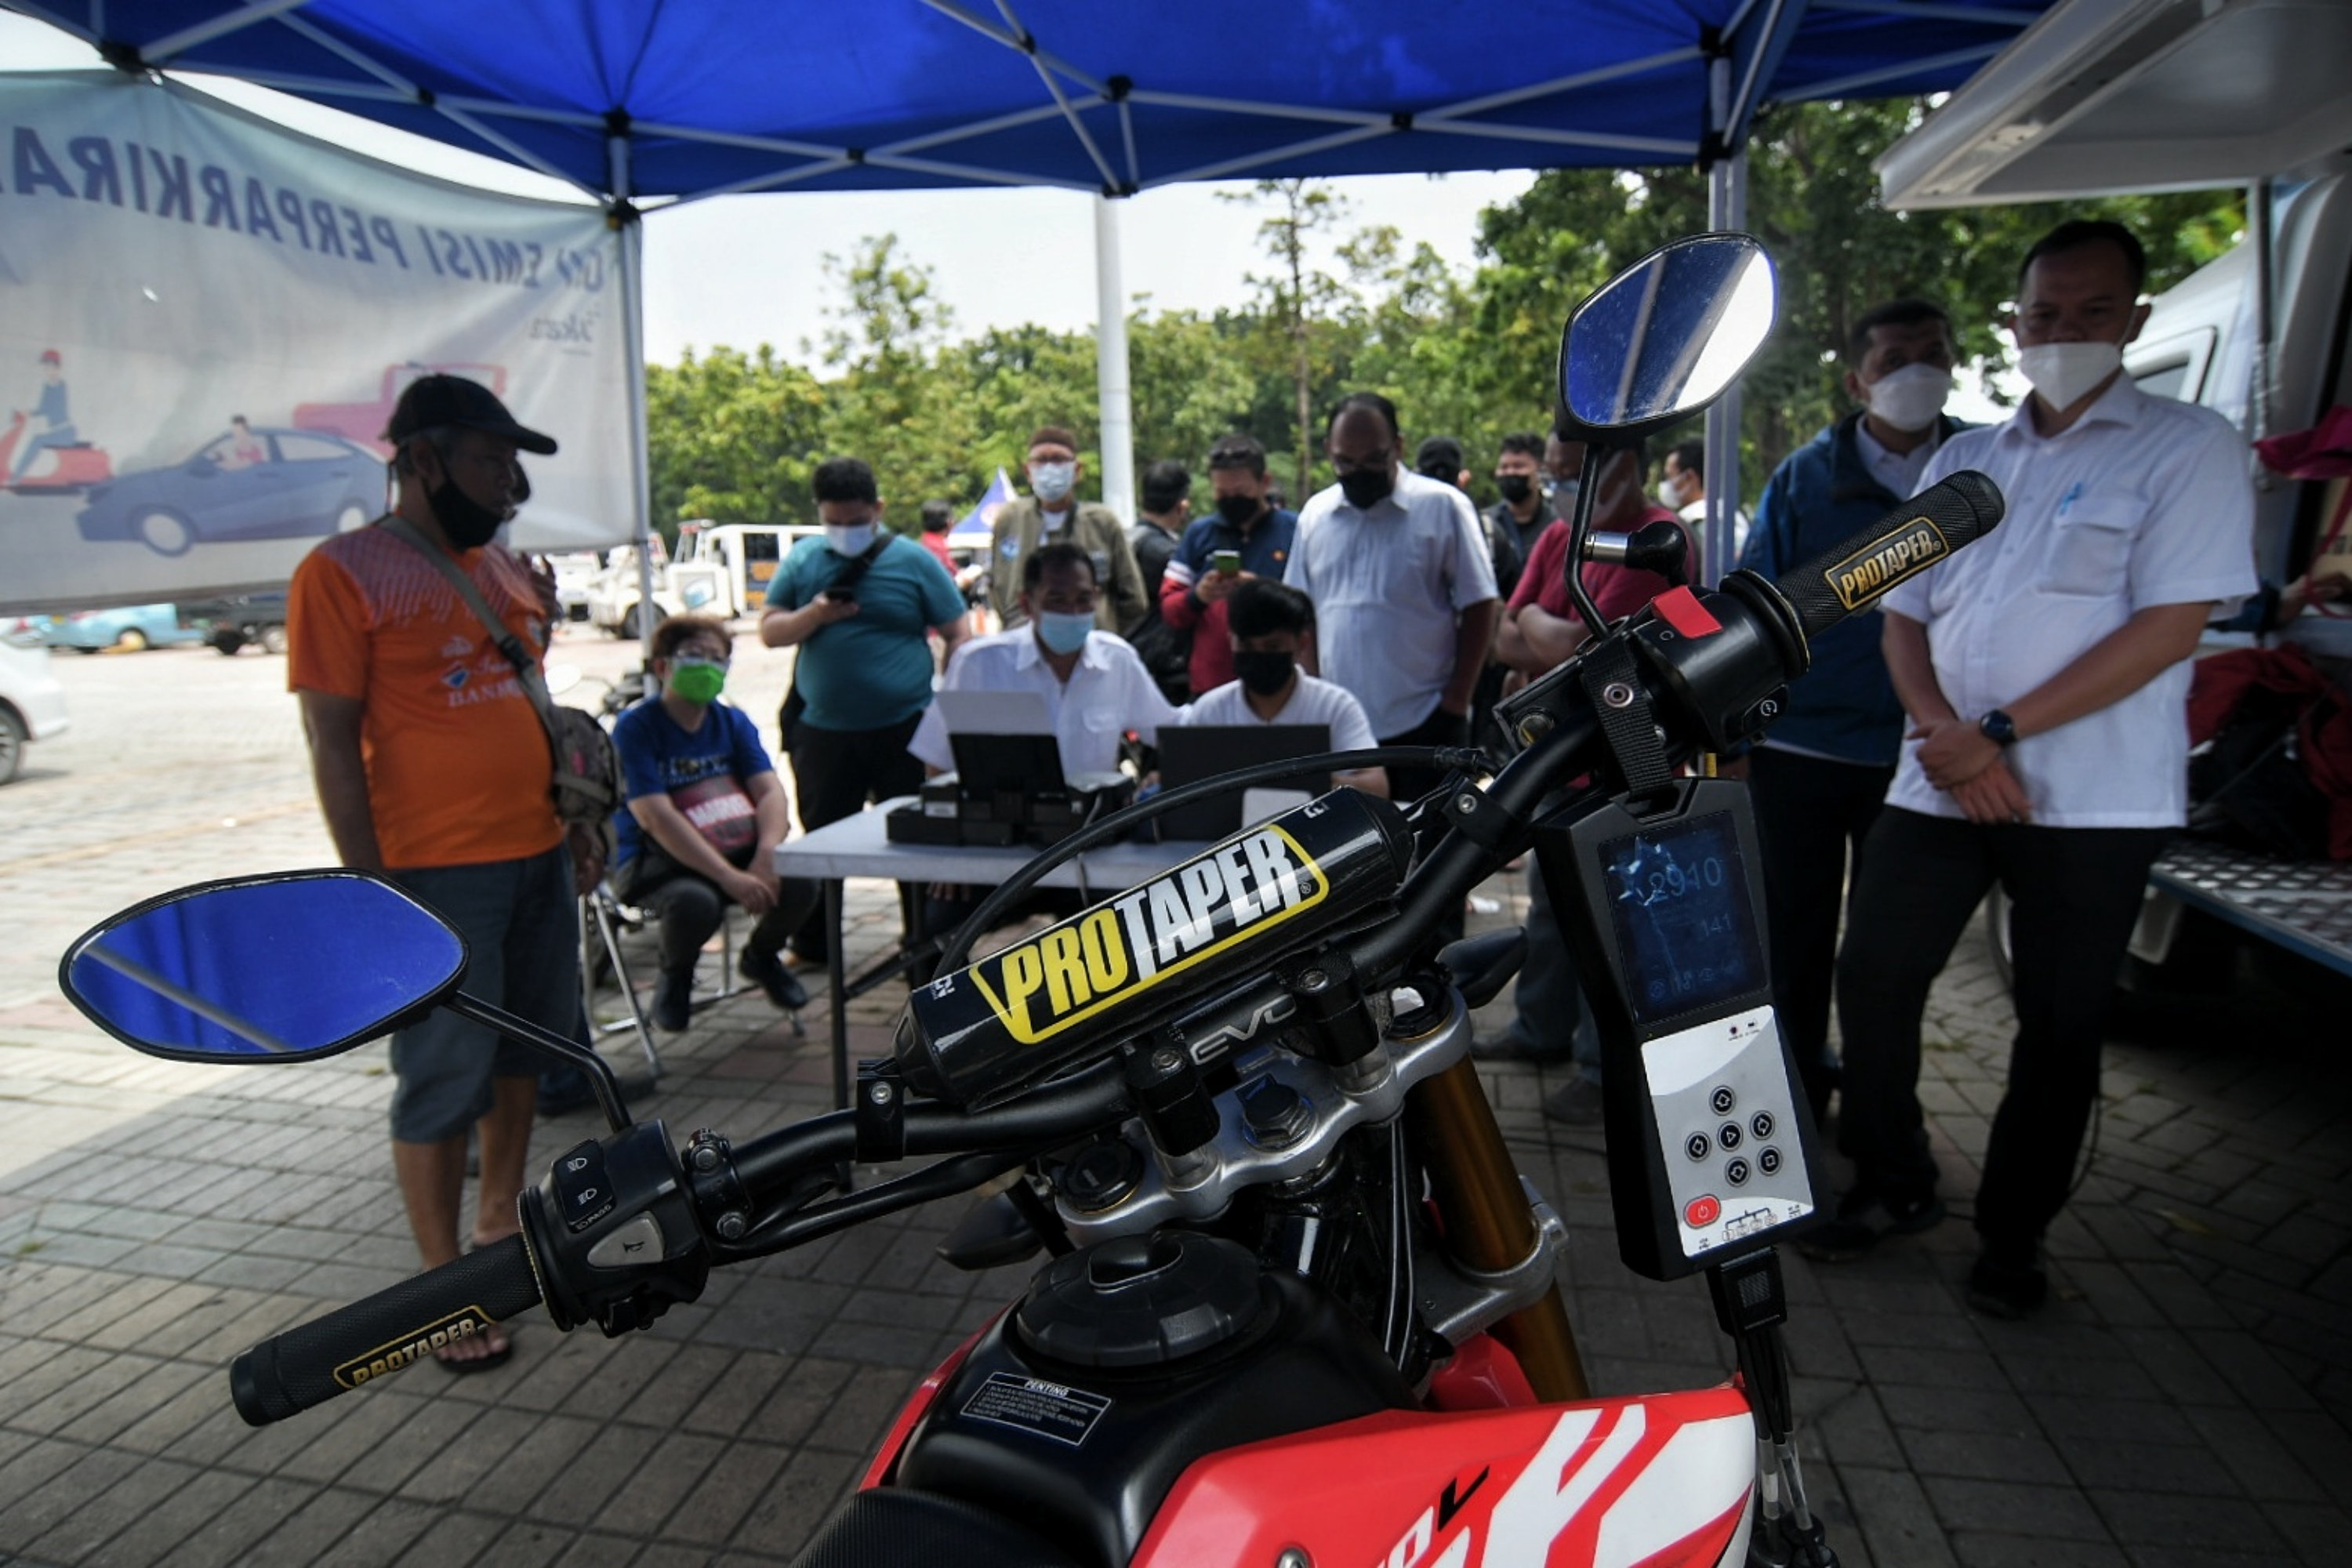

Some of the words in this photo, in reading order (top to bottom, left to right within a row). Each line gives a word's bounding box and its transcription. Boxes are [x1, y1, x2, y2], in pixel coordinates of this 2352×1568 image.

[1840, 529, 1934, 605] PROTAPER
[1000, 828, 1301, 1022] PROTAPER
[353, 1318, 477, 1385] PROTAPER
[1024, 1380, 1069, 1399] PENTING
